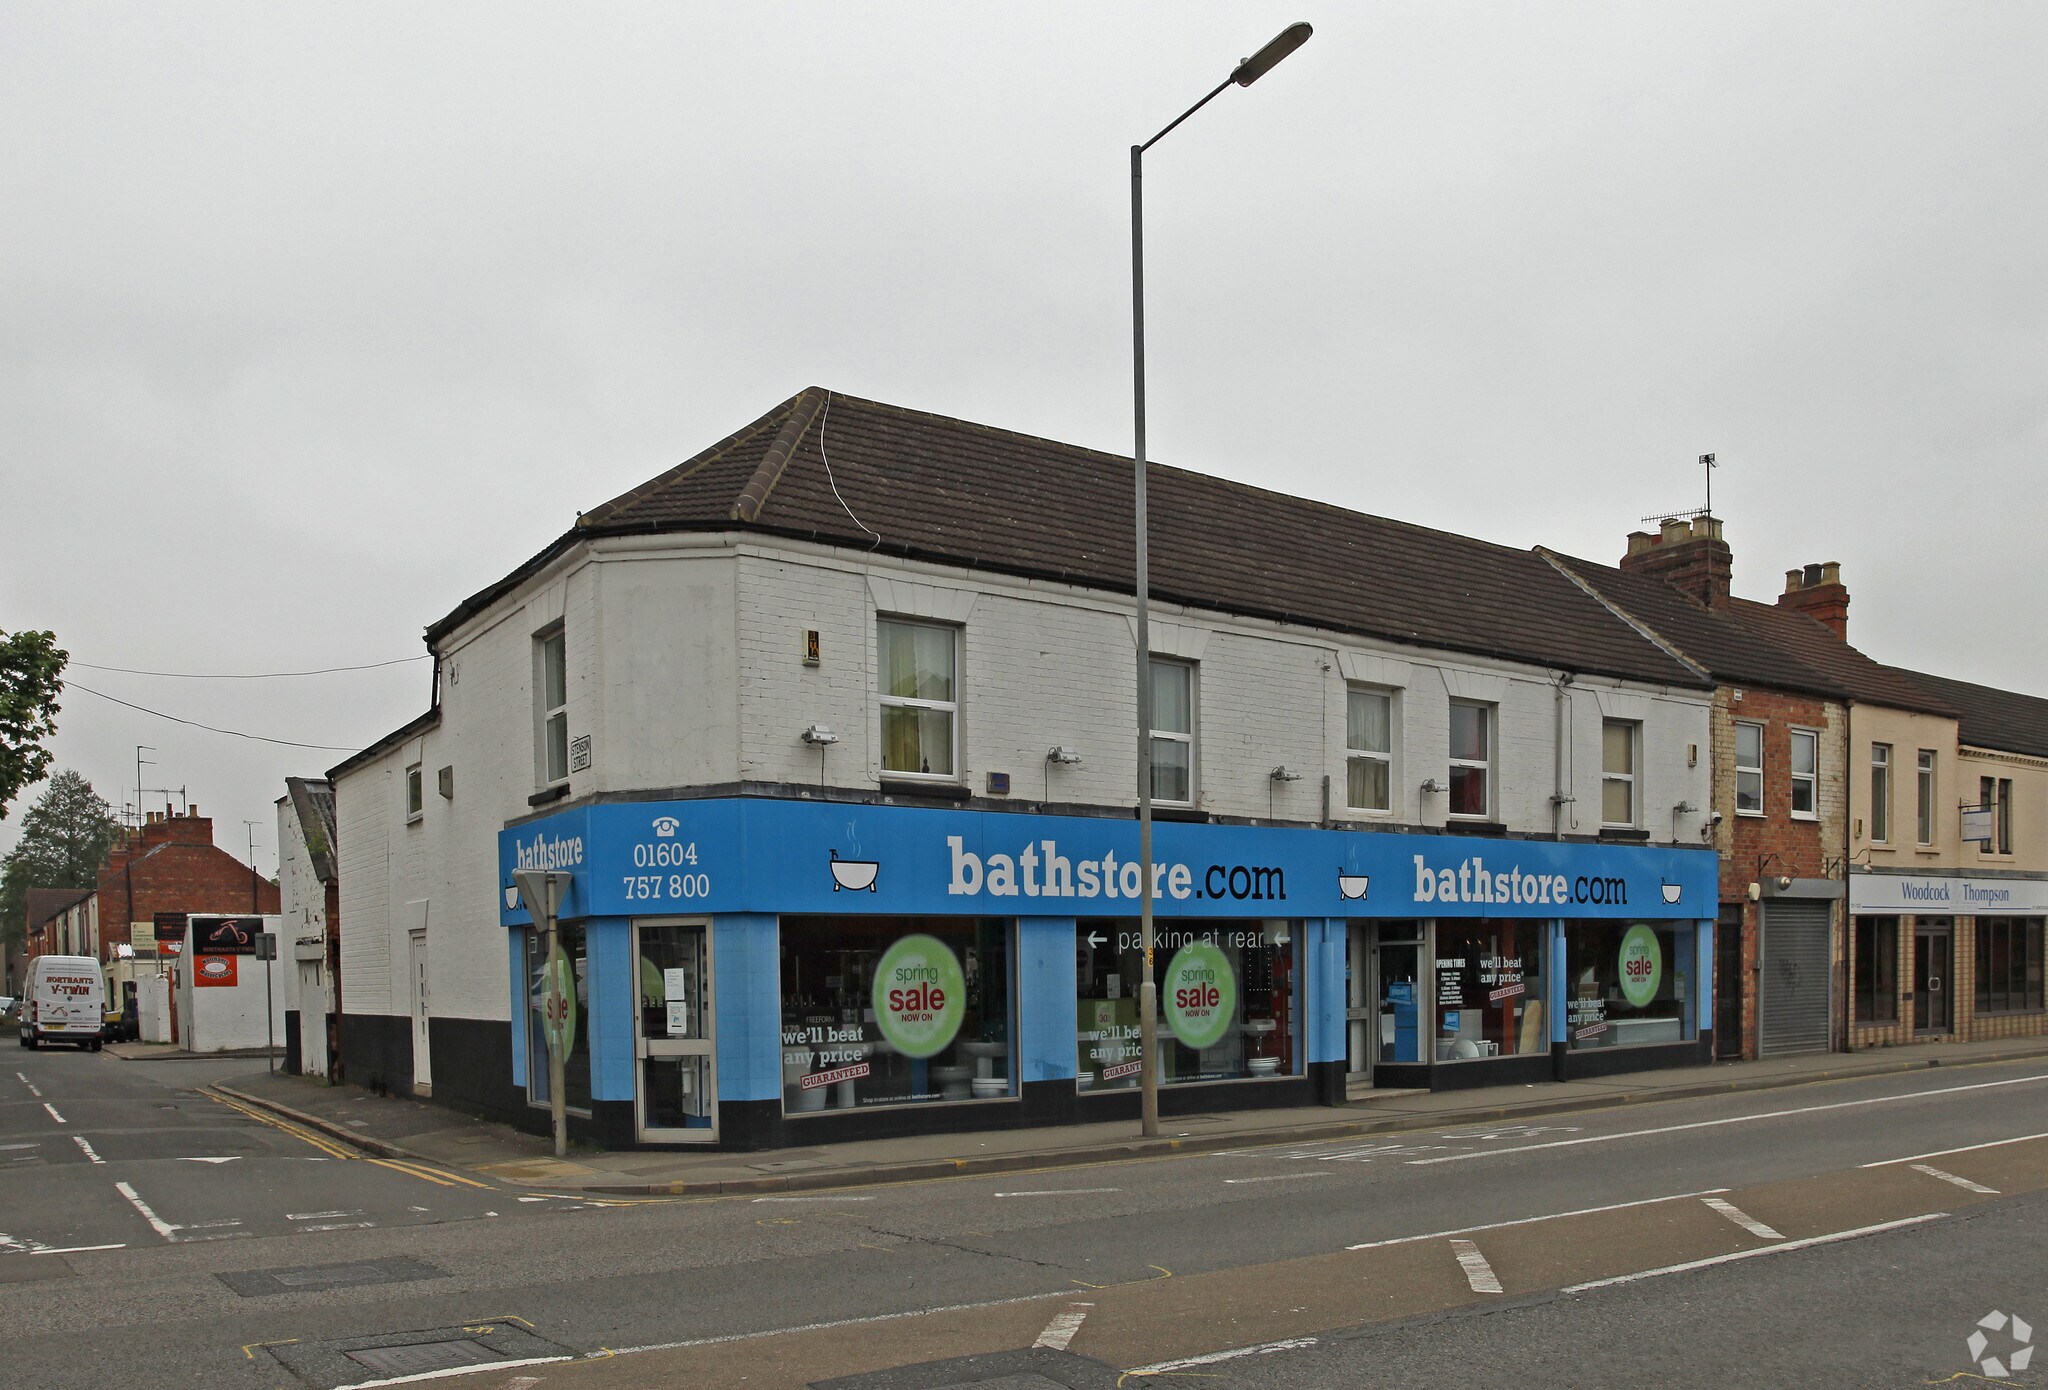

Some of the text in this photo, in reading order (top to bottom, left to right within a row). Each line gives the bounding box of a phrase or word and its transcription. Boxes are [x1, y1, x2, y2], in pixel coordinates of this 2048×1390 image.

[571, 740, 590, 756] STENSON
[573, 753, 588, 768] STREET
[516, 833, 583, 870] bathstore
[633, 842, 698, 868] 01604
[946, 835, 1287, 900] bathstore.com
[623, 873, 710, 899] 757 800
[1413, 854, 1628, 905] bathstore.com
[1901, 881, 2009, 906] Woodcock Thompson
[1118, 926, 1194, 955] paking
[1202, 929, 1219, 949] at
[1629, 944, 1650, 957] spring
[1436, 958, 1466, 969] OPENING TIMES
[1480, 956, 1522, 969] we'll beat
[1626, 955, 1652, 976] sale
[46, 976, 94, 985] NORTHANTS
[895, 963, 939, 985] spring
[1181, 966, 1215, 985] spring
[1480, 973, 1497, 986] any
[51, 984, 91, 996] V-TWIN
[889, 981, 945, 1012] sale
[1176, 981, 1220, 1009] sale
[547, 991, 569, 1020] sle
[1567, 997, 1605, 1009] we'll beat
[805, 1015, 836, 1024] FREEFORM
[901, 1012, 933, 1022] NOW ON
[1185, 1009, 1210, 1018] NOW ON
[1568, 1013, 1583, 1025] any
[782, 1026, 864, 1045] we'll beat
[1088, 1025, 1142, 1041] we'll be
[783, 1050, 816, 1068] any
[1089, 1042, 1142, 1062] any pric
[803, 1065, 869, 1087] GUARANTEED
[1104, 1062, 1142, 1078] GUARANT
